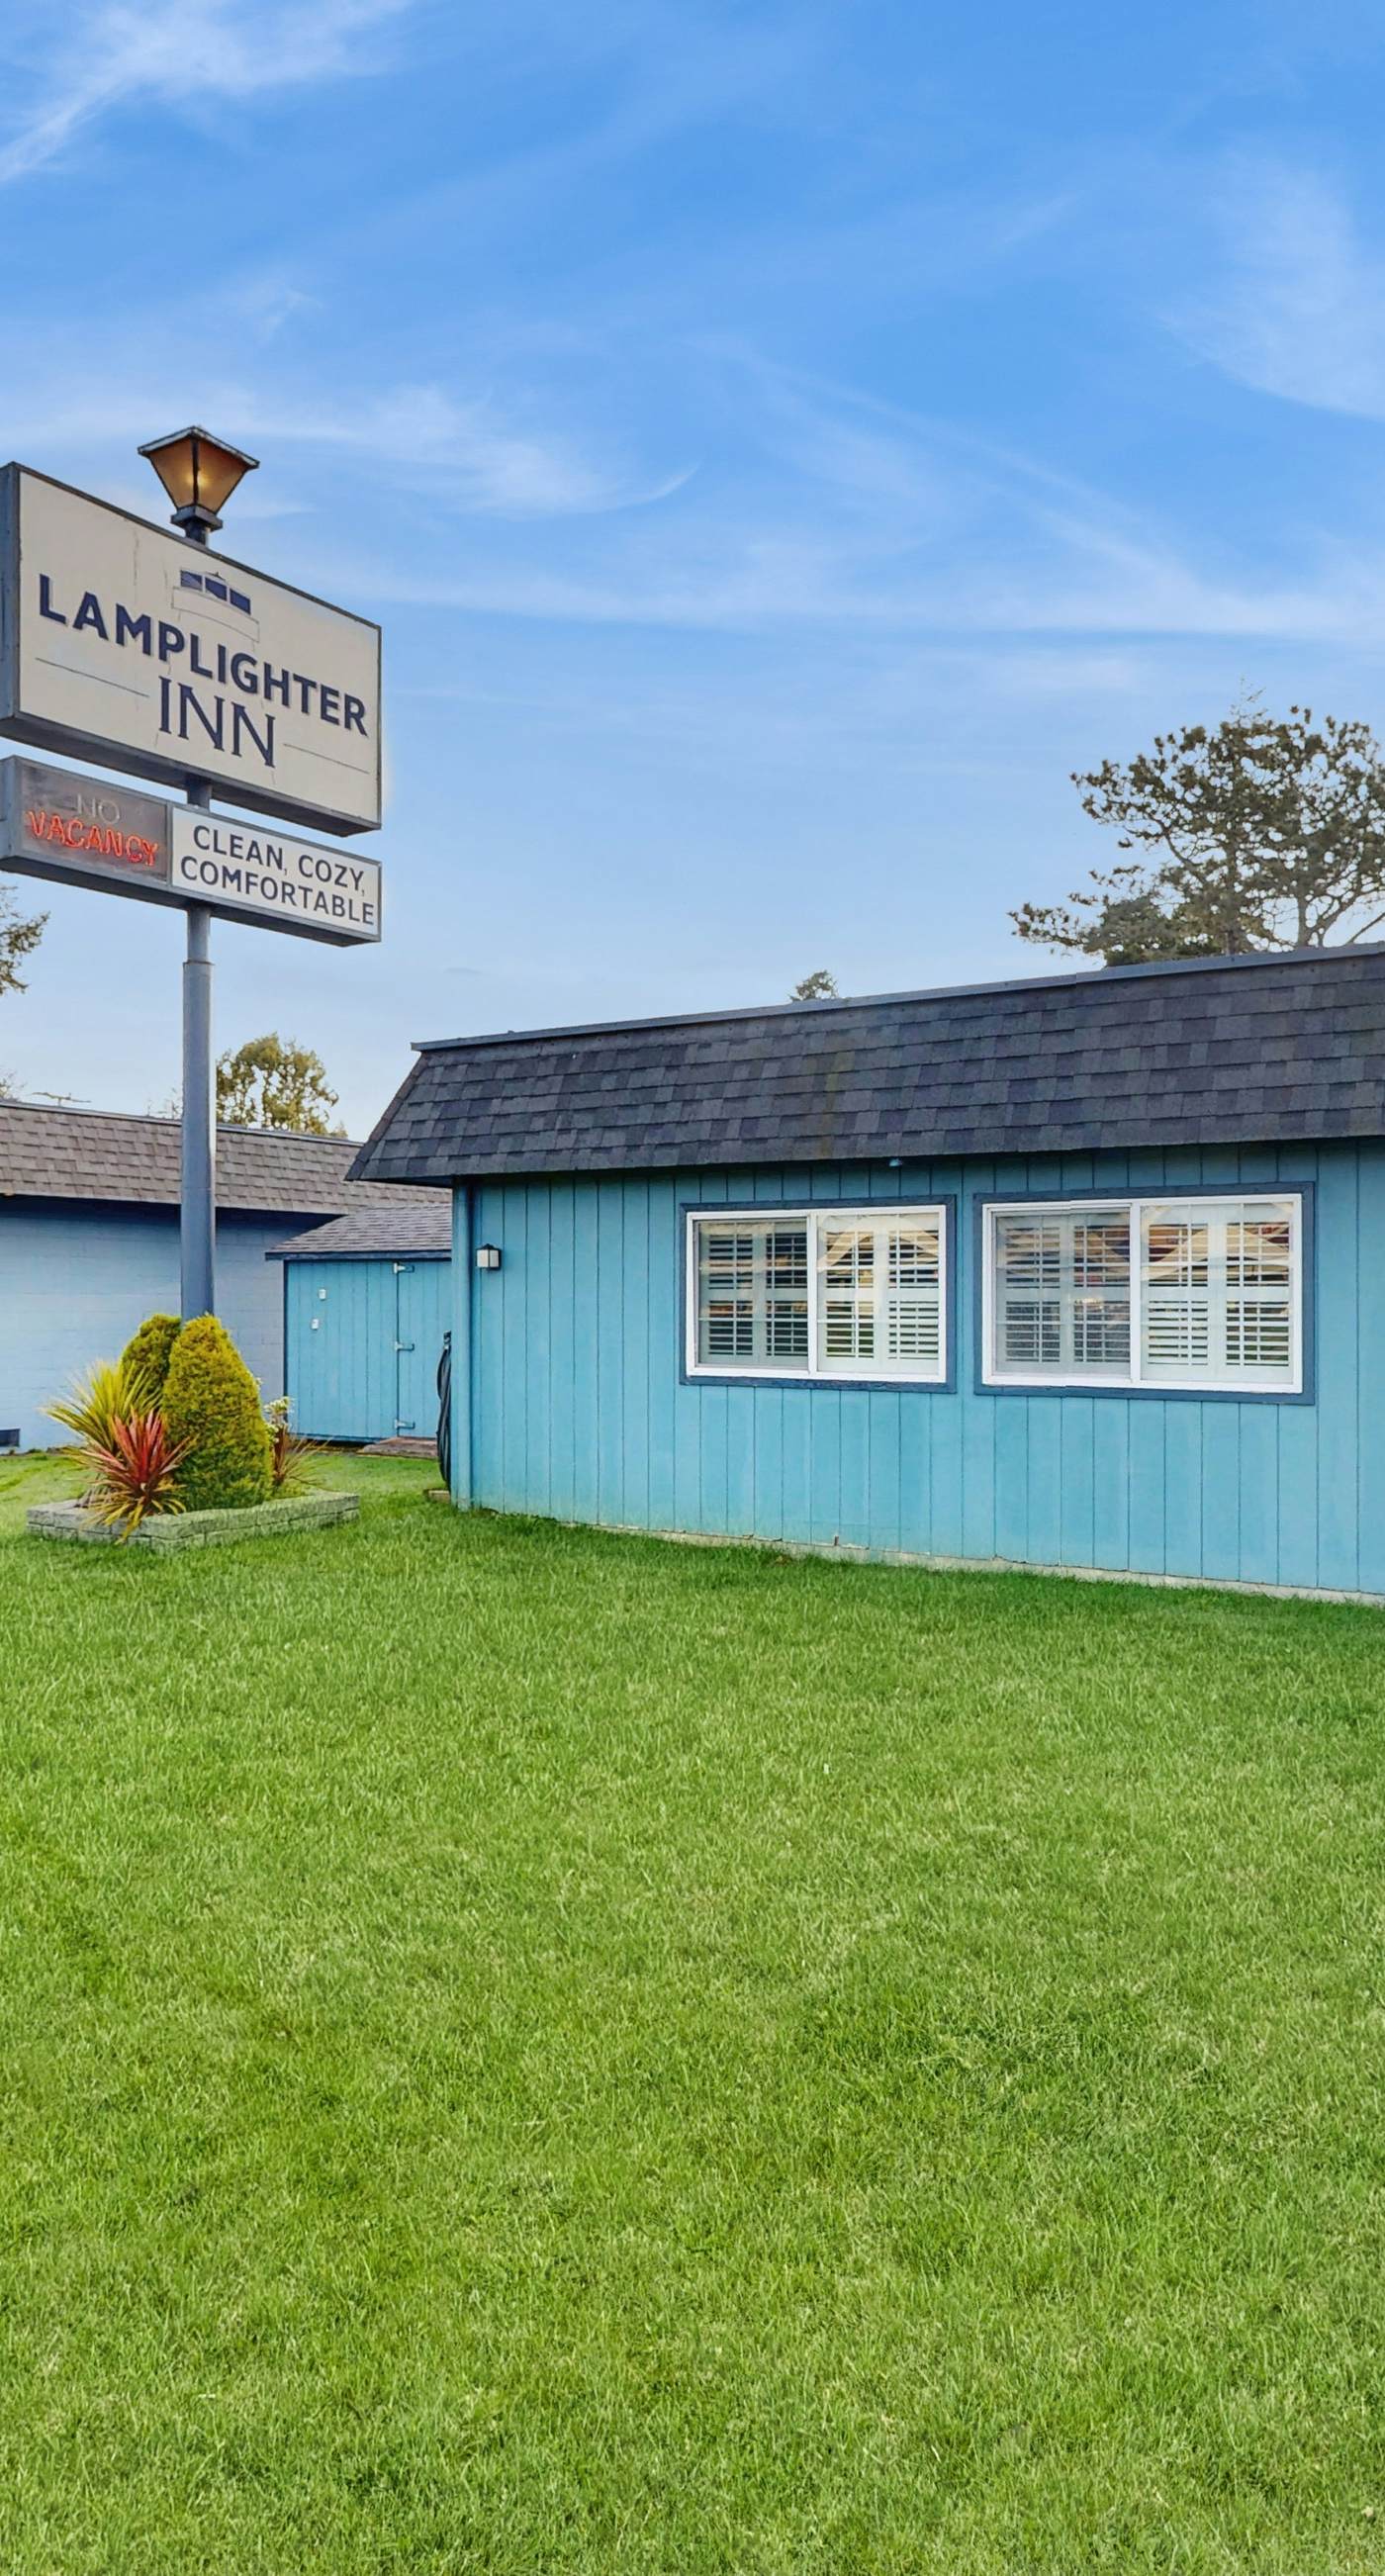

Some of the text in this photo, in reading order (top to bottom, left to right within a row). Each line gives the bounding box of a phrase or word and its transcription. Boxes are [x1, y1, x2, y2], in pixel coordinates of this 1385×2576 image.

[39, 574, 369, 737] LAMPLIGHTER
[158, 675, 276, 769] INN
[26, 809, 159, 867] VACANCY
[74, 792, 121, 825] NO
[180, 856, 374, 926] COMFORTABLE
[193, 825, 366, 896] CLEAN, COZY,
